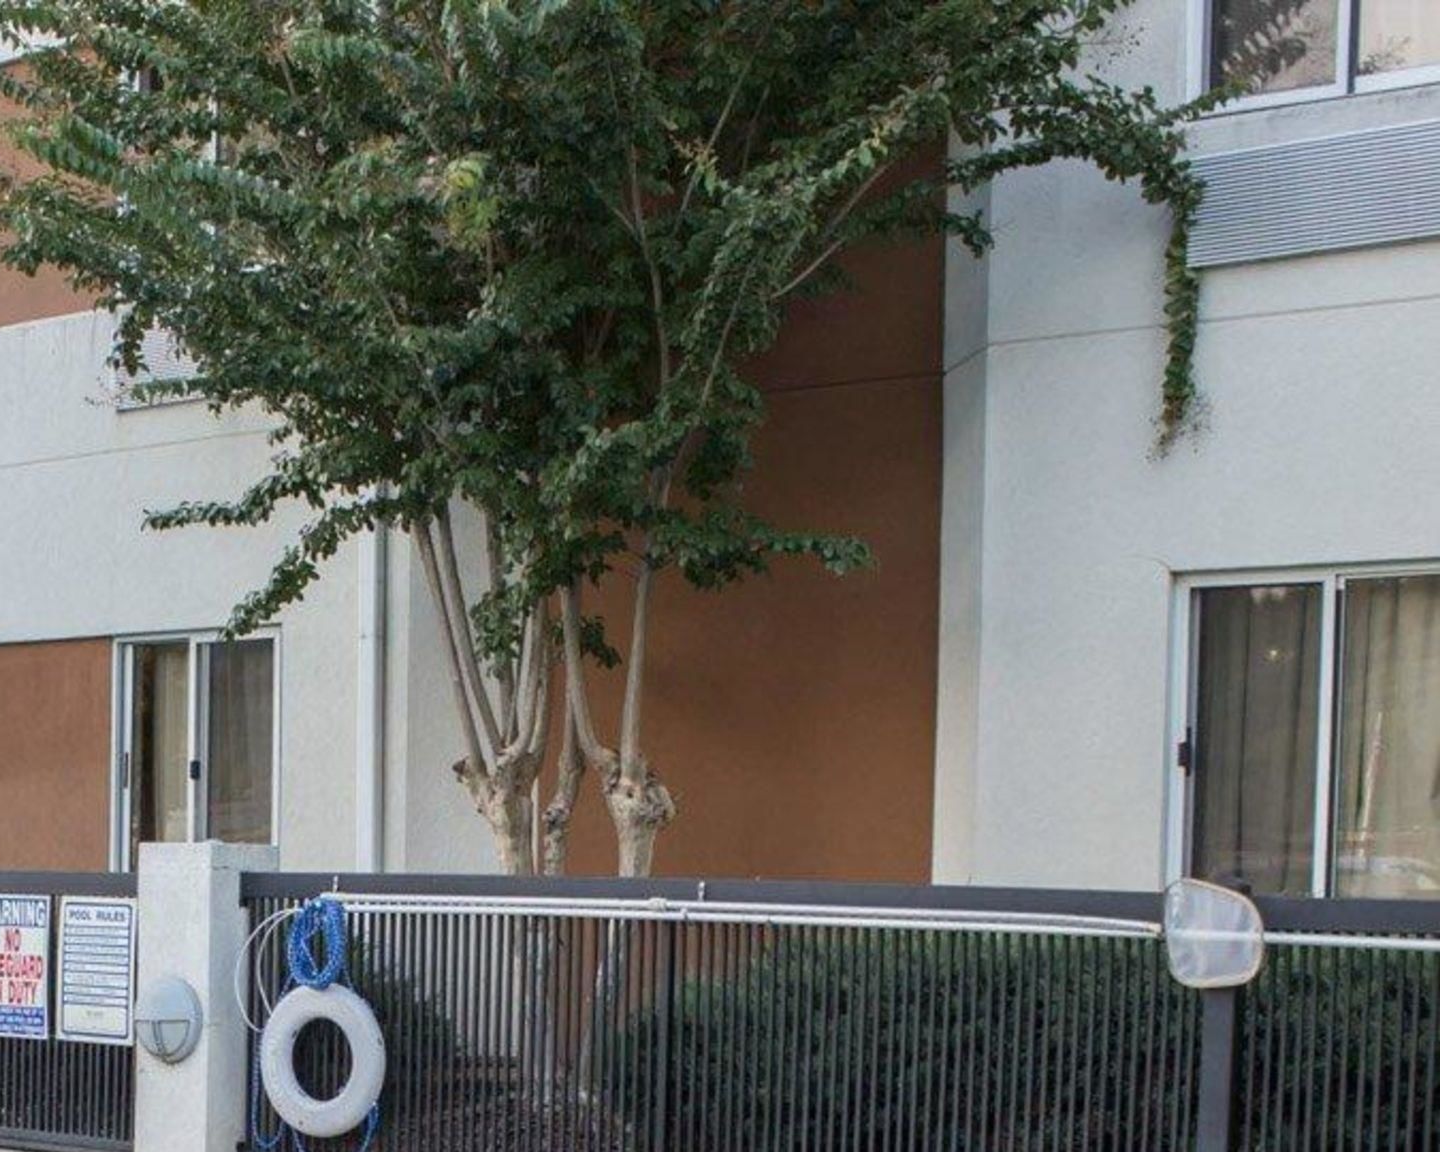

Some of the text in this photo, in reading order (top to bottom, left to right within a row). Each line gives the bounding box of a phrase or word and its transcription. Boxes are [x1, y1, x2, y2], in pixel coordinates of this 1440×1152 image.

[68, 909, 126, 922] POOL RULES
[4, 929, 22, 951] NO
[8, 981, 38, 1004] DUTY
